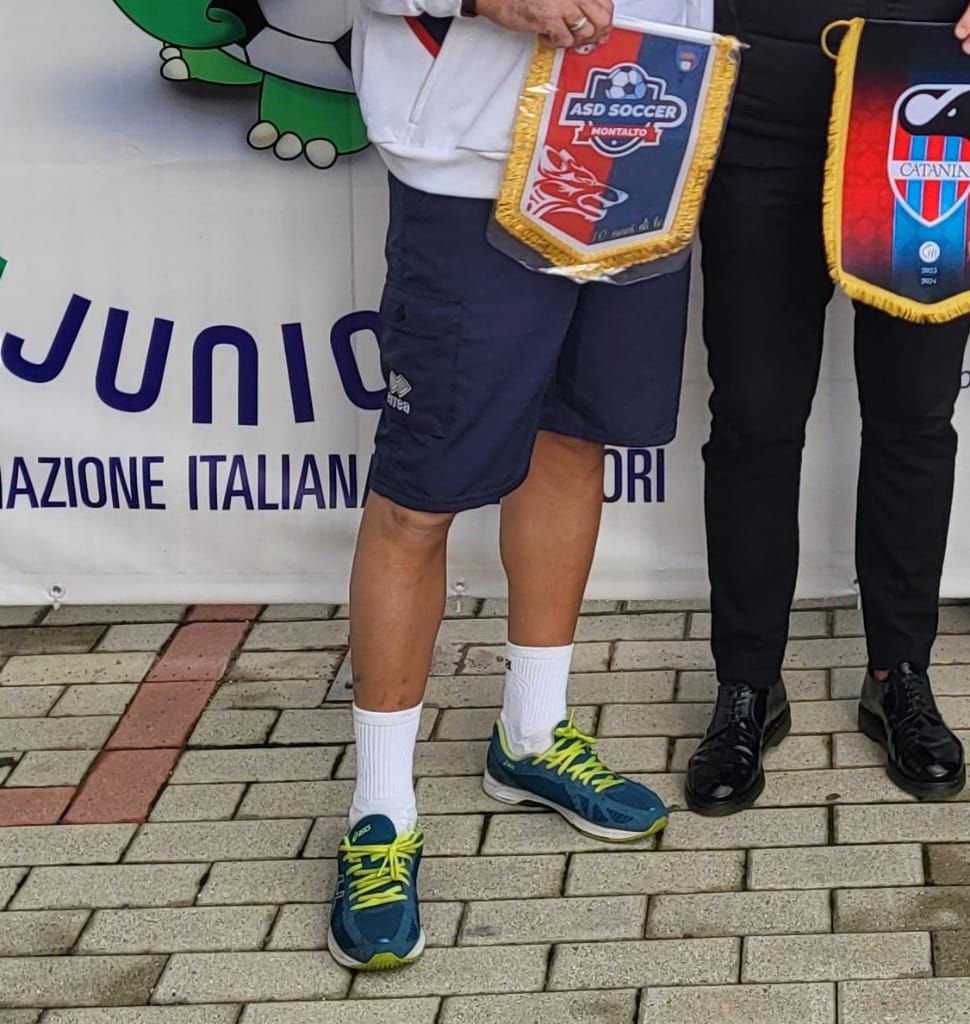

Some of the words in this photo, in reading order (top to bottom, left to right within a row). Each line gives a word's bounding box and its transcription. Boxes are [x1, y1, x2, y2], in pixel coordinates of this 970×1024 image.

[570, 102, 606, 116] ASD
[608, 104, 677, 119] SOCCER
[591, 127, 647, 137] MONTALTO
[900, 162, 970, 178] CATANIA
[0, 455, 166, 510] AZIONE
[602, 448, 665, 503] ORI
